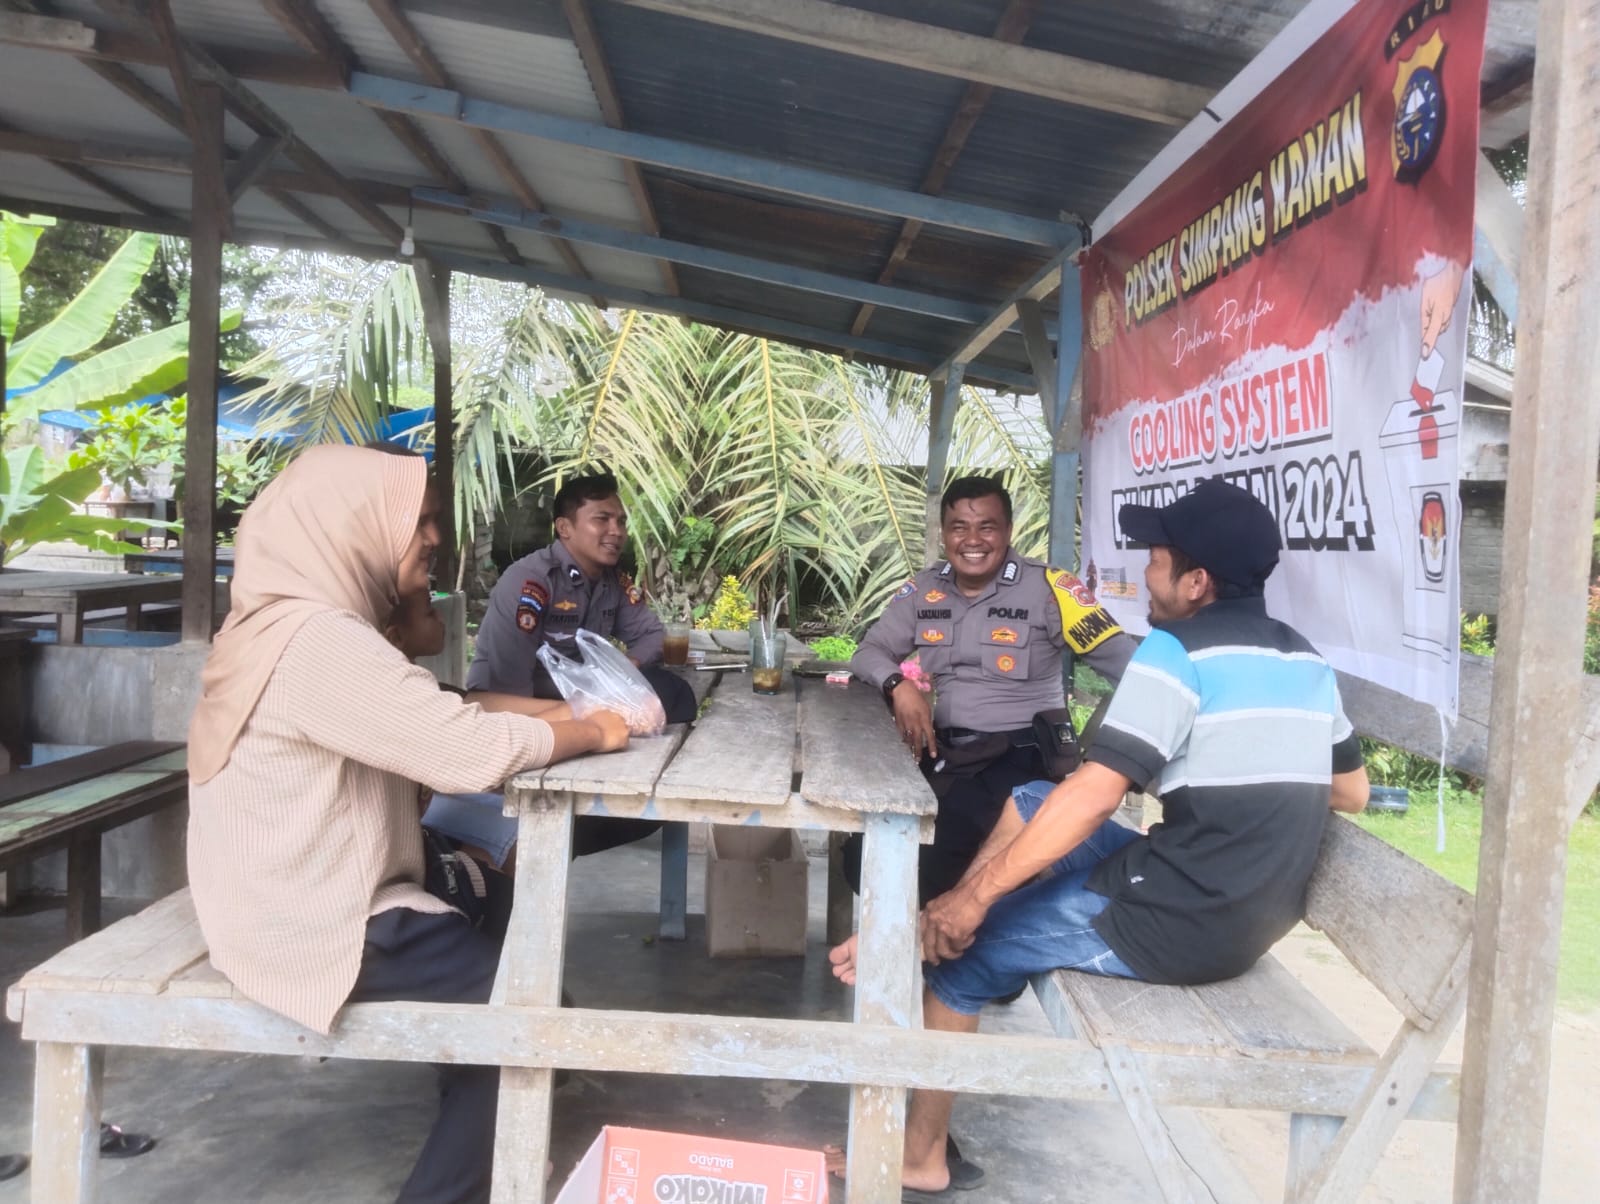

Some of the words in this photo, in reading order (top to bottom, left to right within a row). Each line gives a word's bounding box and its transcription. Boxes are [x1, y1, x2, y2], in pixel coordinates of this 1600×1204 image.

[1125, 237, 1178, 326] POLSEK
[1179, 171, 1267, 292] SIMPANG
[1269, 92, 1366, 234] KANAN
[1172, 319, 1216, 368] Dalam
[1215, 281, 1275, 352] Rangka
[1129, 390, 1215, 470] COOLING
[1220, 352, 1331, 450] SYSTEM
[1282, 451, 1373, 548] 2024
[987, 607, 1029, 620] POLRI
[688, 1154, 734, 1169] BALADO
